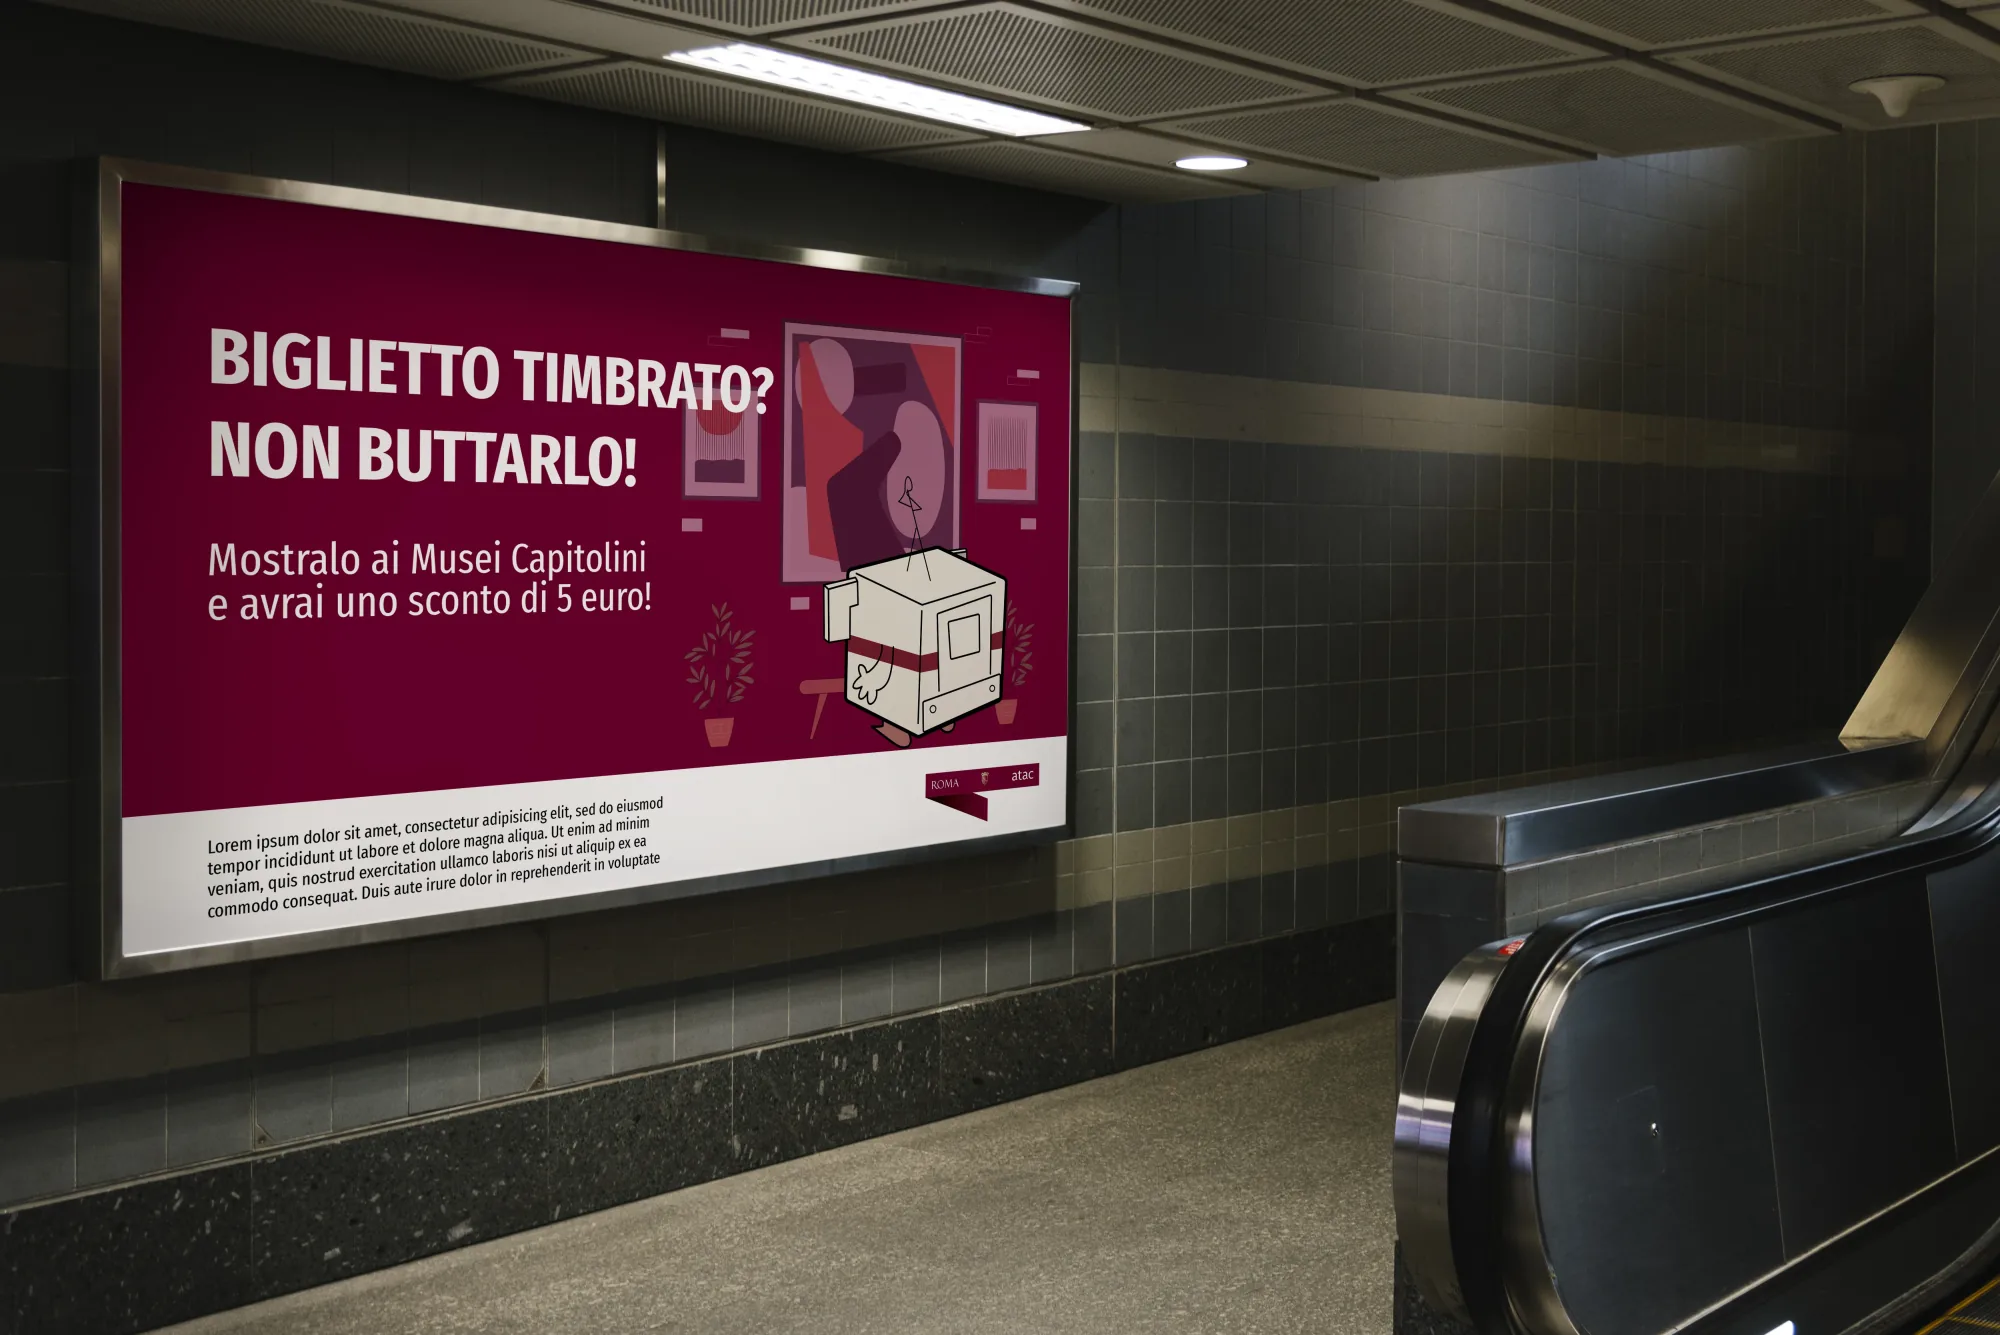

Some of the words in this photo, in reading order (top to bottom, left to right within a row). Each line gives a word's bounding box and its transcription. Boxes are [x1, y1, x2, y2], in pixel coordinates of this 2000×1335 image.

[211, 328, 499, 399] BIGLIETTO
[514, 350, 773, 414] TIMBRATO?
[212, 421, 339, 479] NON
[359, 427, 636, 487] BUTTARLO!
[209, 541, 359, 576] Mostralo
[372, 540, 399, 574] ai
[412, 540, 500, 574] Musei
[512, 540, 645, 581] Capitolini
[209, 595, 227, 620] e
[240, 583, 323, 620] avrai
[338, 592, 397, 617] uno
[409, 586, 510, 616] sconto
[521, 580, 546, 613] di
[557, 584, 572, 612] 5
[582, 582, 650, 612] euro!
[931, 778, 959, 790] ROMA
[1011, 770, 1034, 781] atac
[207, 859, 261, 876] tempor
[265, 850, 335, 869] incididunt
[339, 848, 353, 861] ut
[357, 844, 399, 859] labore
[403, 841, 415, 854] et
[419, 837, 460, 852] dolore
[464, 834, 504, 849] magna
[508, 828, 547, 844] aliqua.
[551, 825, 564, 838] Ut
[567, 821, 595, 836] enim
[599, 819, 612, 833] ad
[616, 816, 649, 831] minim
[208, 839, 252, 854] Lorem
[257, 834, 299, 852] ipsum
[304, 828, 340, 844] dolor
[344, 825, 361, 840] sit
[365, 823, 401, 838] amet,
[405, 817, 479, 834] consectetur
[482, 810, 547, 827] adipisicing
[550, 806, 572, 820] elit,
[576, 803, 595, 817] sed
[599, 801, 613, 814] do
[617, 796, 663, 813] eiusmod
[207, 878, 264, 896] veniam,
[268, 873, 297, 893] quis
[303, 866, 354, 886] nostrud
[359, 858, 436, 879] exercitation
[441, 855, 488, 870] ullamco
[493, 846, 534, 864] laboris
[537, 843, 557, 858] nisi
[562, 844, 573, 856] ut
[576, 838, 615, 855] aliquip
[618, 839, 631, 849] ex
[634, 837, 646, 847] ea
[208, 897, 278, 918] commodo
[283, 889, 357, 909] consequat.
[362, 883, 390, 899] Duis
[394, 882, 422, 895] aute
[427, 877, 456, 891] irure
[460, 872, 492, 887] dolor
[496, 869, 506, 883] in
[511, 859, 591, 883] reprehenderit
[594, 859, 605, 872] in
[608, 853, 660, 869] voluptate
